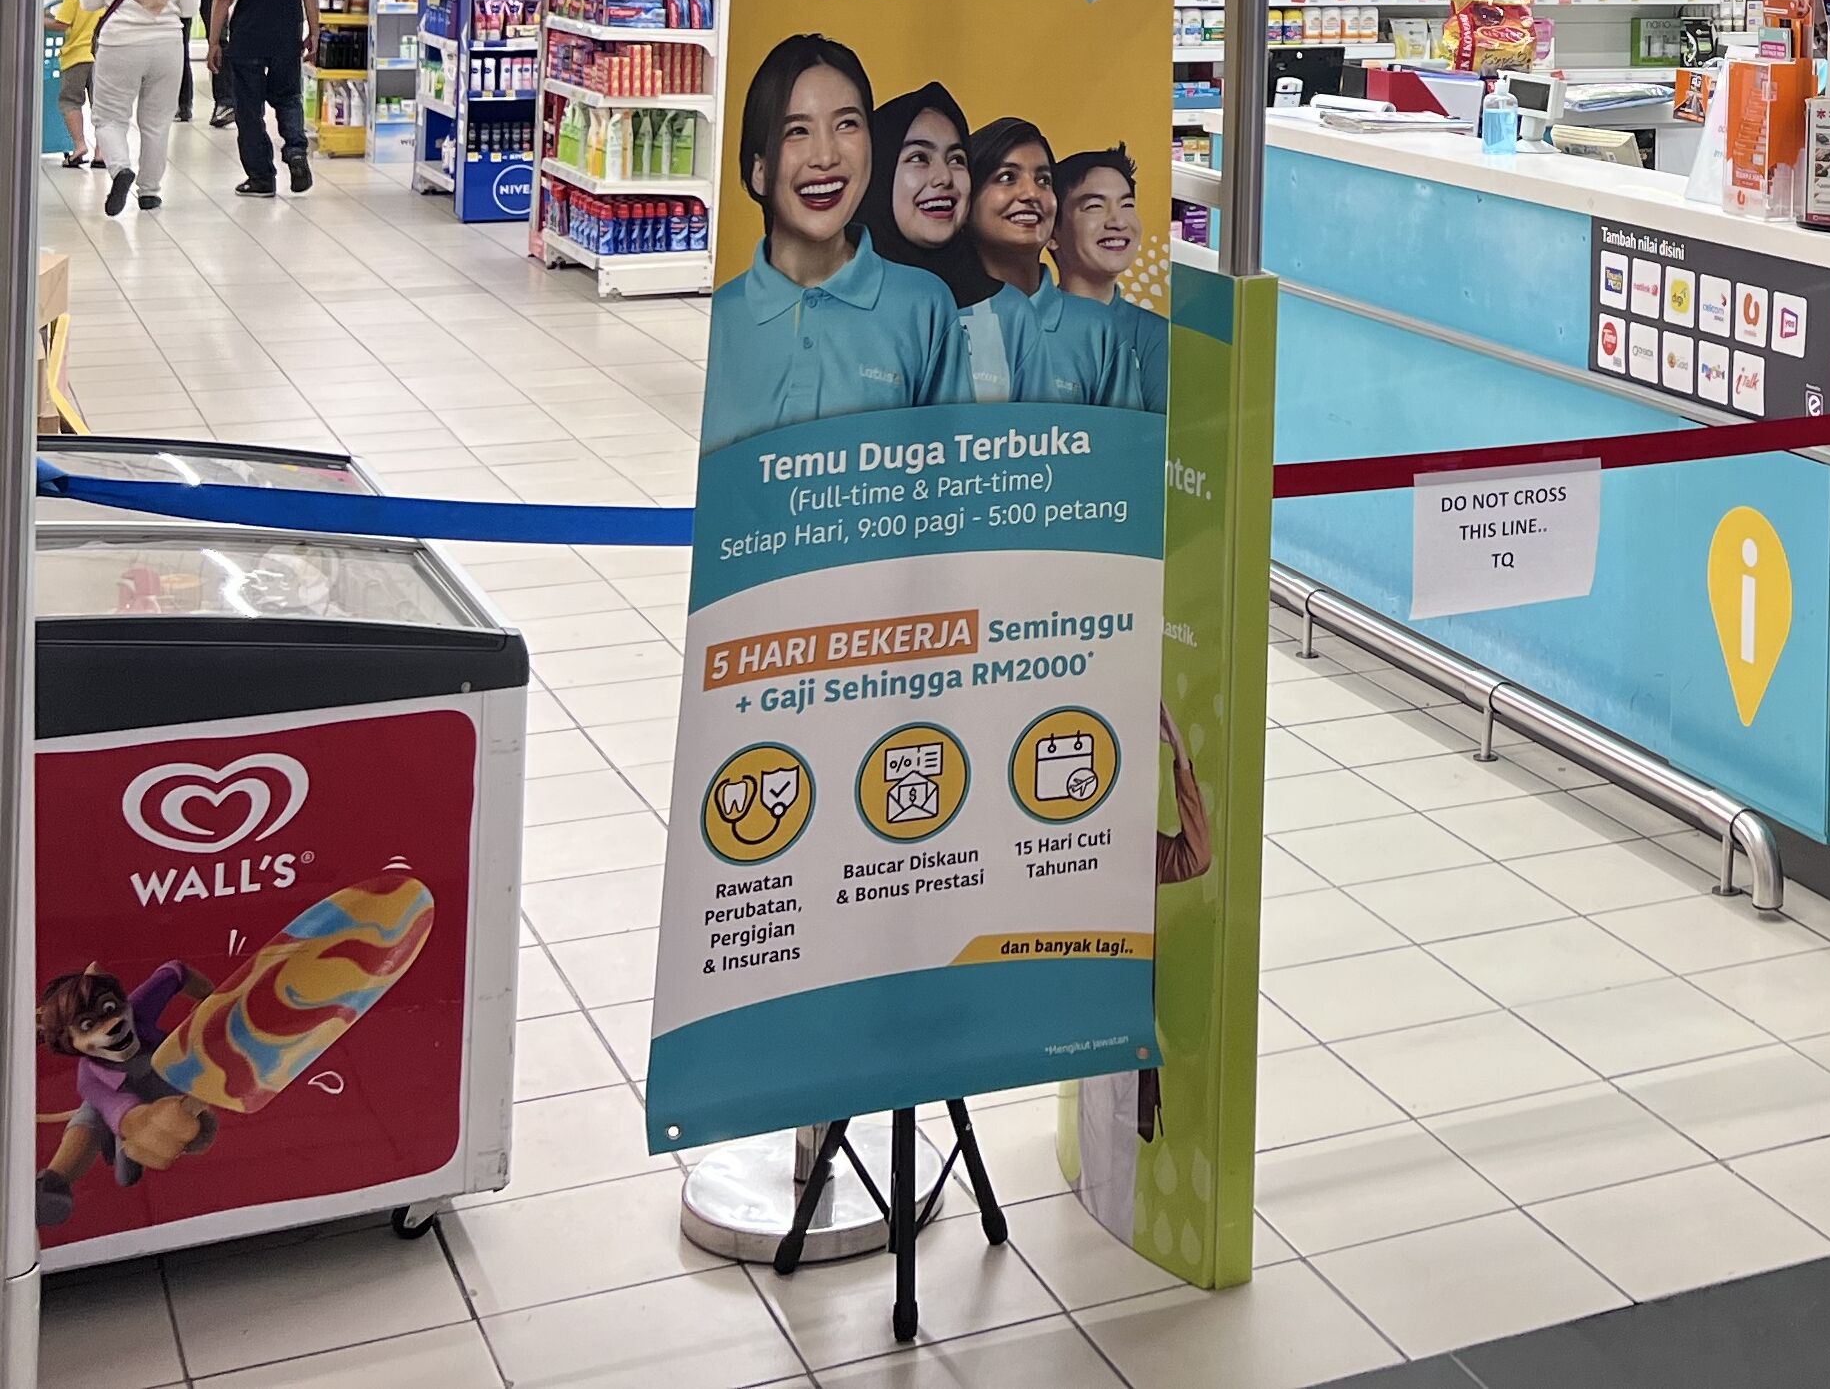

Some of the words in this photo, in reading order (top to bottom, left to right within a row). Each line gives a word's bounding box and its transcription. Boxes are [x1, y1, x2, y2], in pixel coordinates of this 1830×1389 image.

[500, 183, 532, 196] NIVE
[1601, 226, 1637, 250] Tambah
[1638, 235, 1658, 255] nilai
[1659, 239, 1685, 261] disini
[759, 452, 847, 484] Temu
[858, 442, 946, 477] Duga
[954, 426, 1091, 463] Terbuka
[788, 481, 905, 516] (Full-time
[912, 480, 930, 501] &
[937, 463, 1054, 498] Part-time)
[1440, 495, 1467, 513] DO
[1472, 491, 1510, 510] NOT
[1514, 486, 1567, 506] CROSS
[719, 530, 787, 562] Setiap
[794, 518, 849, 547] Hari,
[858, 514, 907, 539] 9:00
[914, 507, 965, 539] pagi
[987, 502, 1037, 527] 5:00
[1044, 498, 1128, 527] petang
[1459, 521, 1497, 541] THIS
[1501, 517, 1548, 537] LINE..
[1491, 551, 1515, 569] TQ
[711, 650, 730, 681] 5
[737, 636, 817, 676] HARI
[826, 618, 973, 662] BEKERJA
[987, 611, 1134, 644] Seminggu
[735, 695, 752, 714] +
[760, 678, 816, 715] Gaji
[823, 666, 963, 704] Sehingga
[1014, 840, 1033, 857] 15
[1038, 833, 1073, 854] Hari
[1077, 828, 1112, 850] Cuti
[843, 858, 904, 880] Baucar
[908, 848, 979, 872] Diskaun
[1025, 856, 1099, 879] Tahunan
[130, 852, 297, 908] WALL'S
[715, 873, 794, 900] Rawatan
[835, 888, 850, 905] &
[854, 881, 910, 902] Bonus
[914, 869, 985, 896] Prestasi
[703, 897, 803, 926] Perubatan,
[709, 920, 796, 949] Pergigian
[1000, 939, 1030, 956] dan
[1034, 938, 1091, 958] banyak
[1095, 937, 1134, 958] lagi..
[702, 958, 716, 975] &
[721, 946, 801, 972] Insurans
[1091, 1034, 1129, 1052] jawatan
